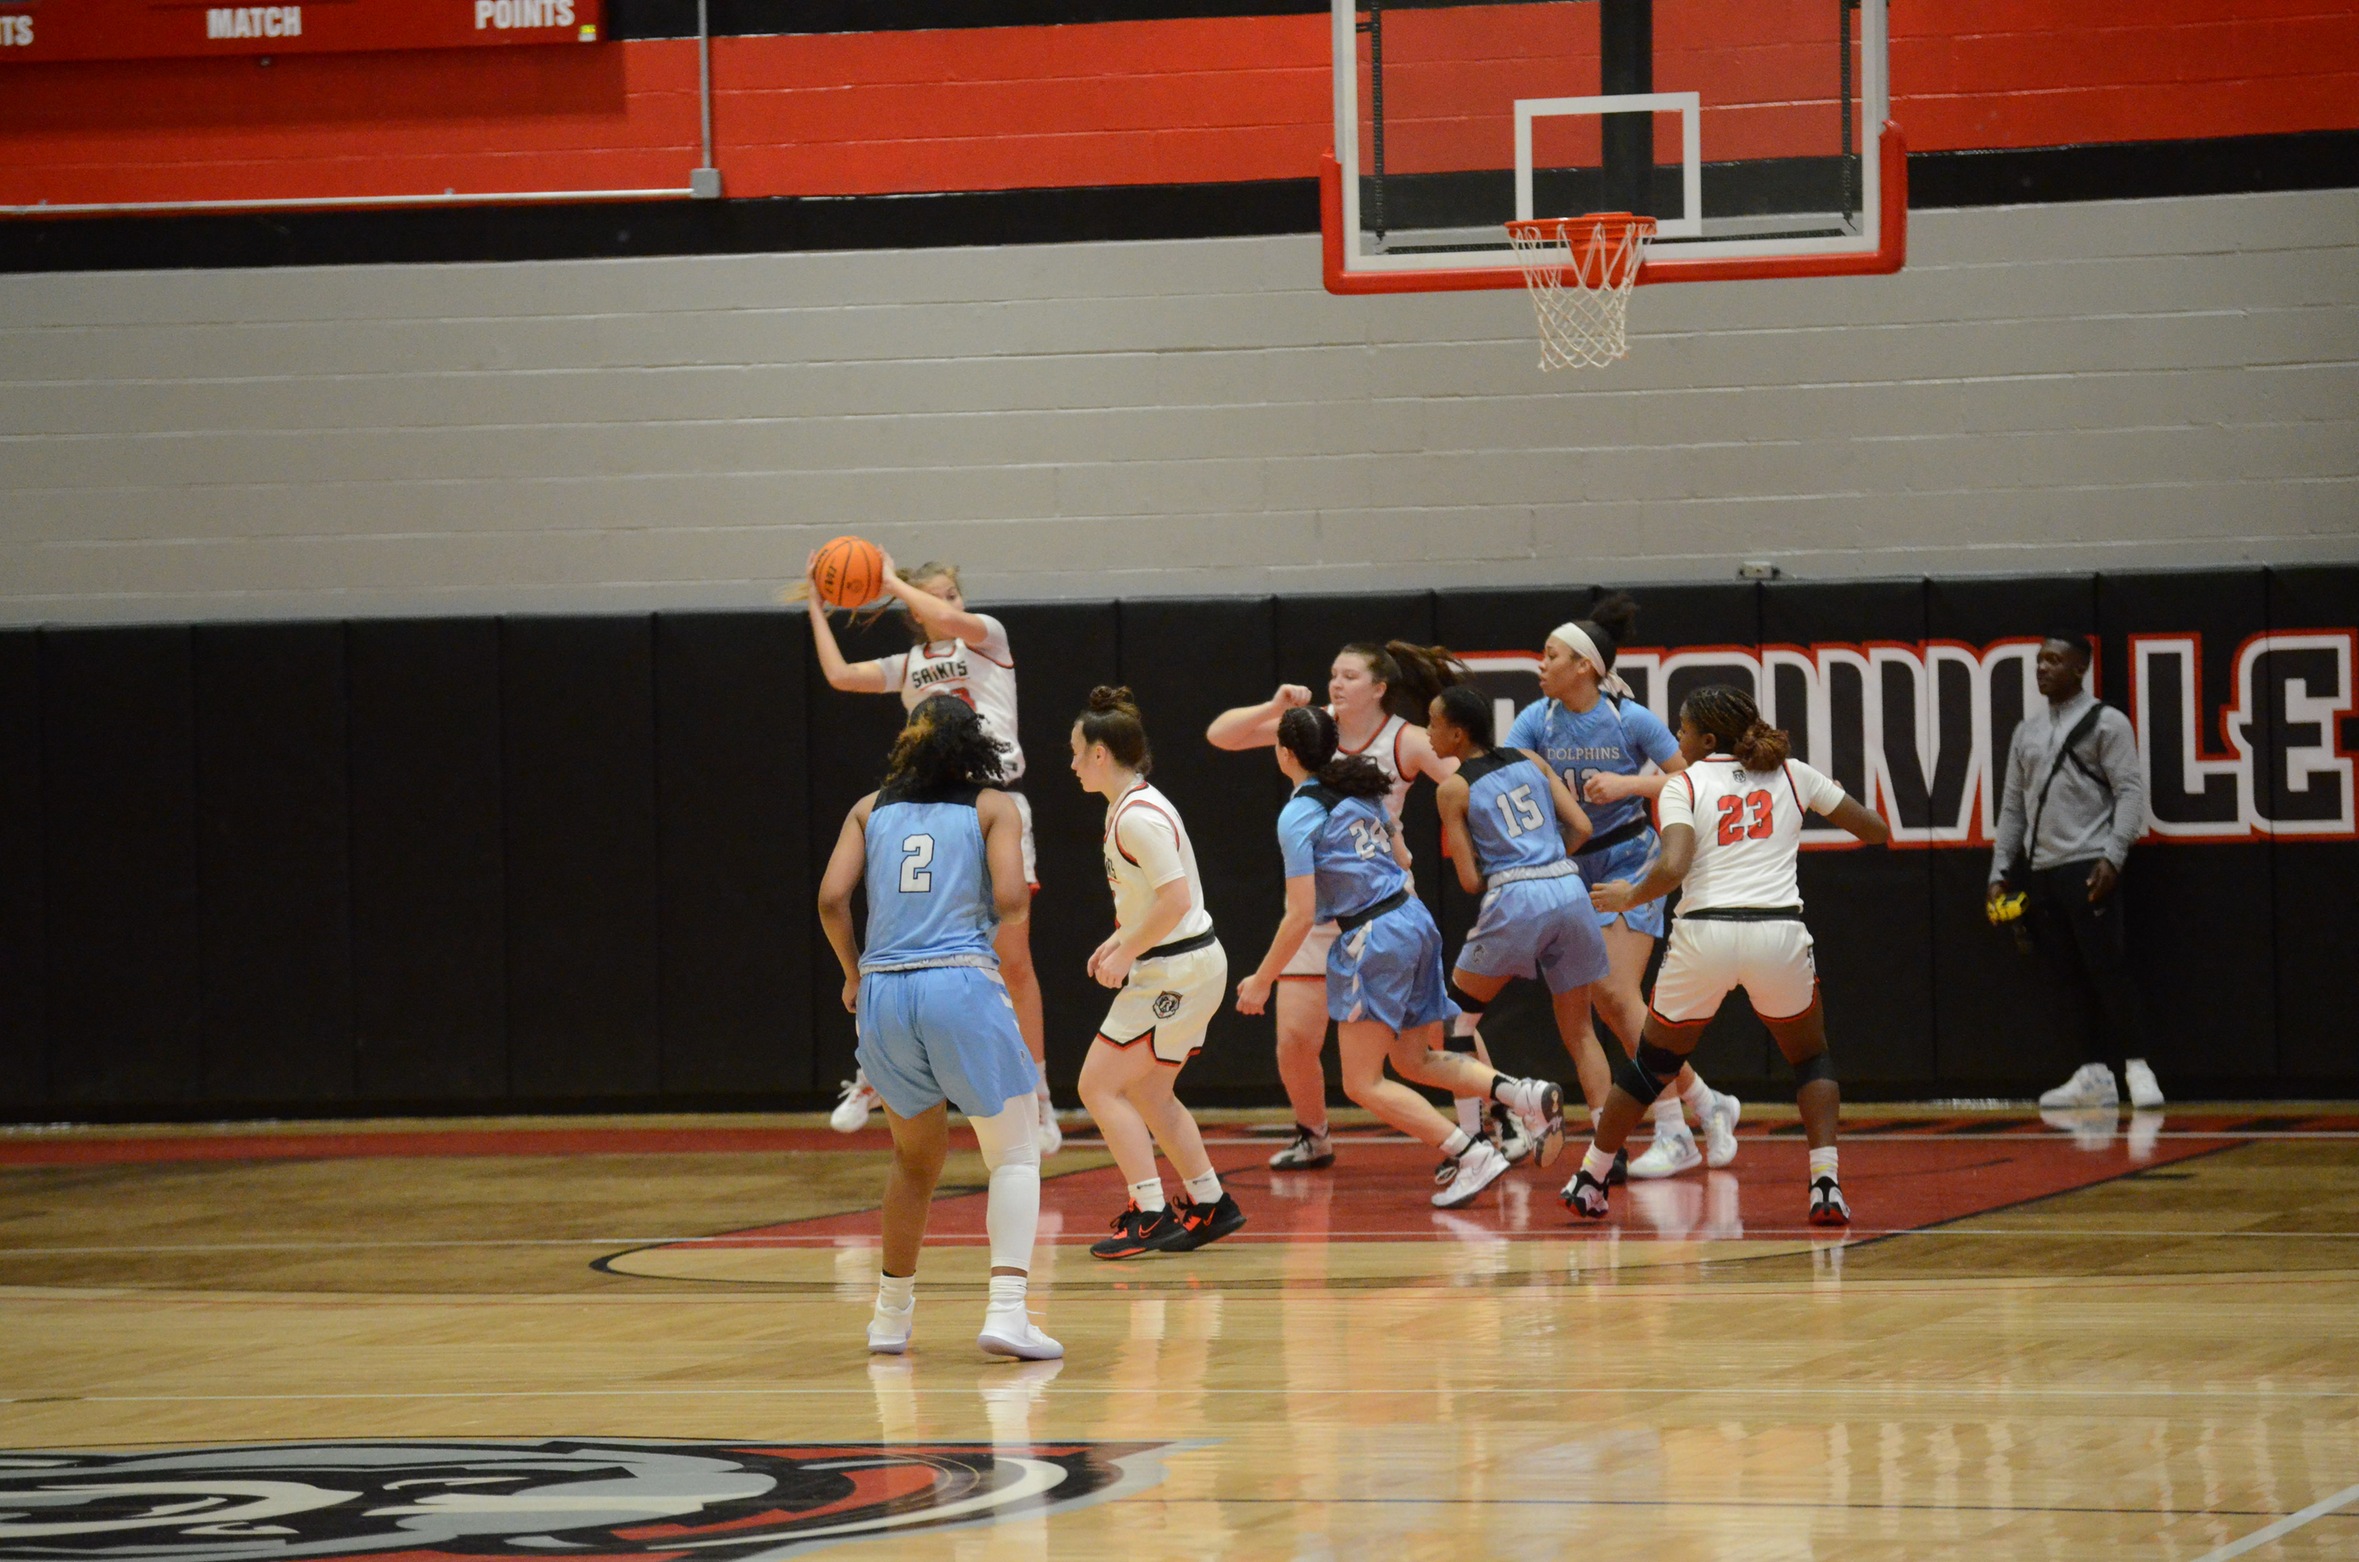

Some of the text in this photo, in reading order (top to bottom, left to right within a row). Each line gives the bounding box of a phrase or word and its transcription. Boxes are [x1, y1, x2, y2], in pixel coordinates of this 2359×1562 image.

[206, 6, 302, 39] MATCH
[474, 0, 575, 29] POINTS
[1547, 747, 1620, 761] DOLPHINS
[1496, 784, 1545, 839] 15
[1717, 789, 1773, 846] 23
[1348, 816, 1392, 860] 24
[899, 833, 935, 893] 2
